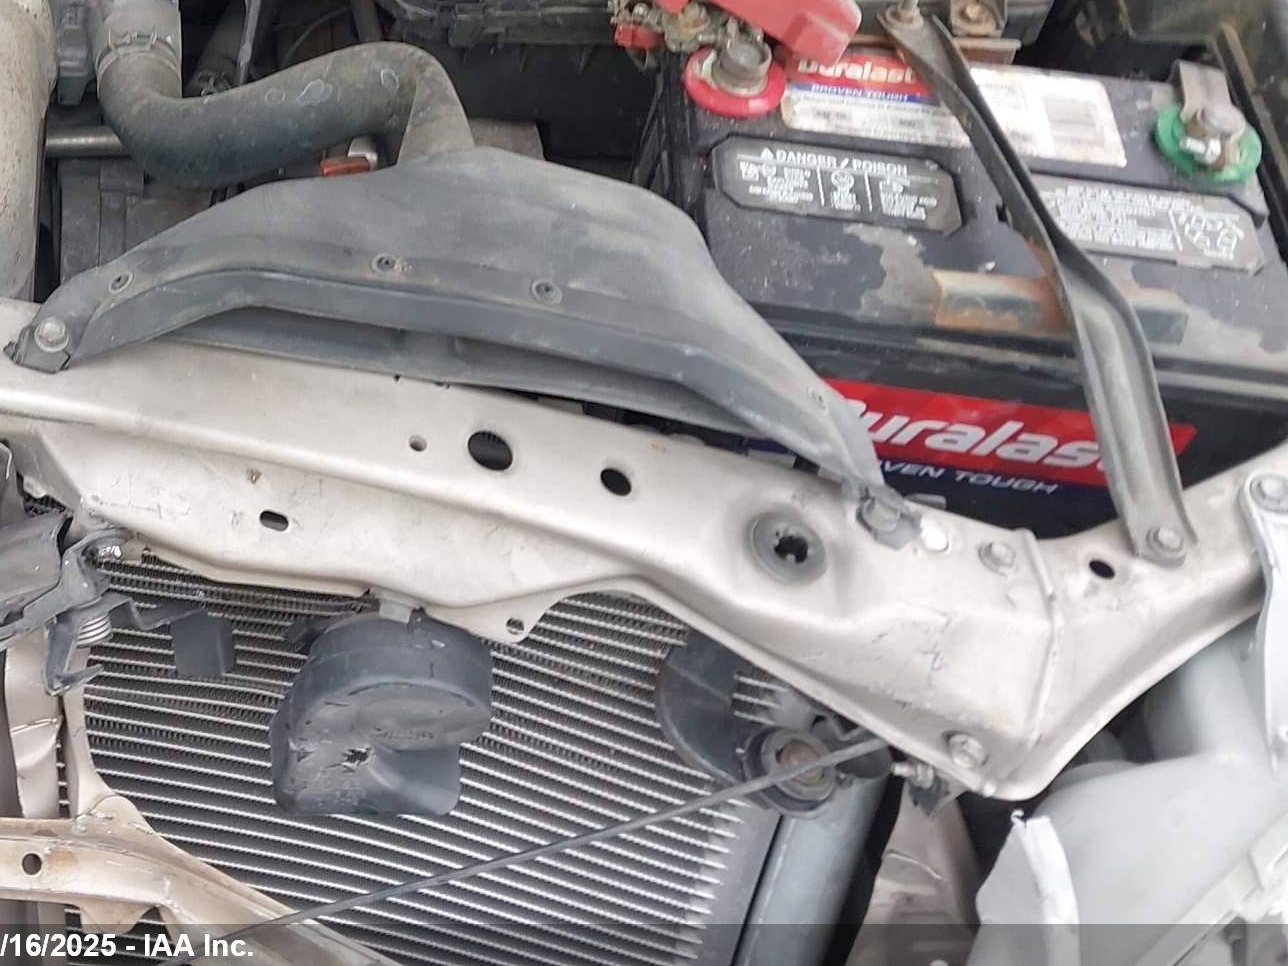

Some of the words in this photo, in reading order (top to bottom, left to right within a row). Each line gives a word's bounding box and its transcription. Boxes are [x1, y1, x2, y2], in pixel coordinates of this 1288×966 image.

[797, 57, 914, 84] Duralast
[775, 150, 837, 168] DANGER
[851, 158, 908, 175] POISON
[843, 398, 1106, 471] uralas
[955, 469, 1060, 495] TOUGH
